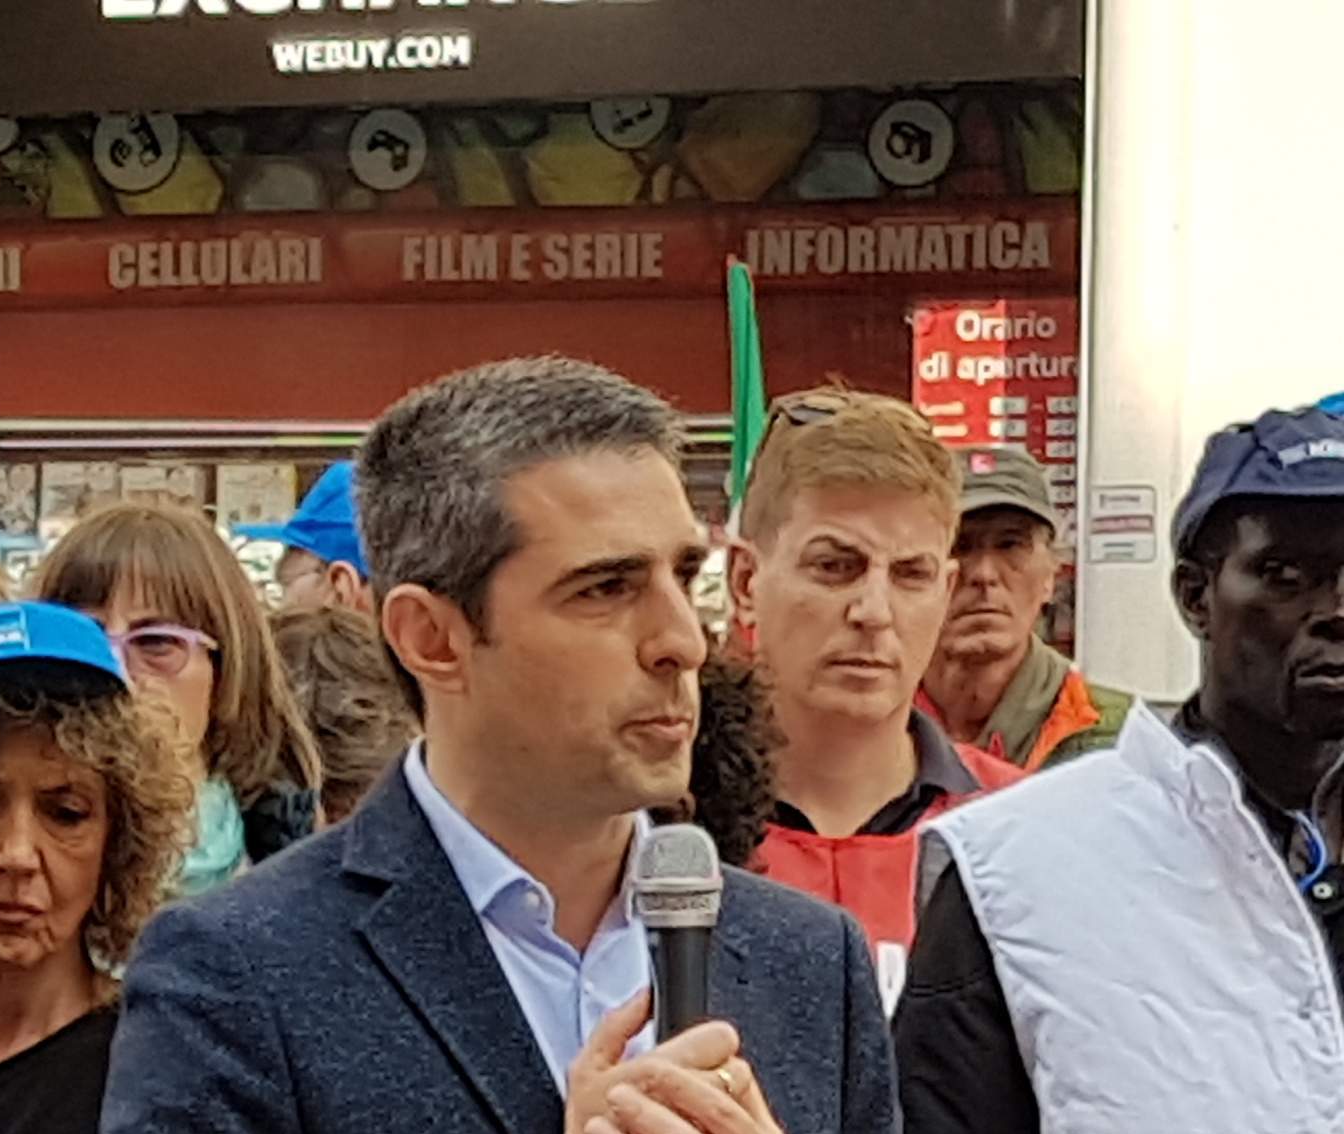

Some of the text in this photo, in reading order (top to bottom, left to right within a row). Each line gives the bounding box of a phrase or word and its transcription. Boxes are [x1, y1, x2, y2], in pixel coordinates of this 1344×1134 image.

[272, 35, 470, 72] WEBUY.COM
[108, 237, 324, 289] CELLULARI
[402, 233, 664, 281] FILM E SERIE
[748, 222, 1051, 275] INFORMATICA
[956, 310, 1057, 341] Orario
[919, 352, 951, 381] di
